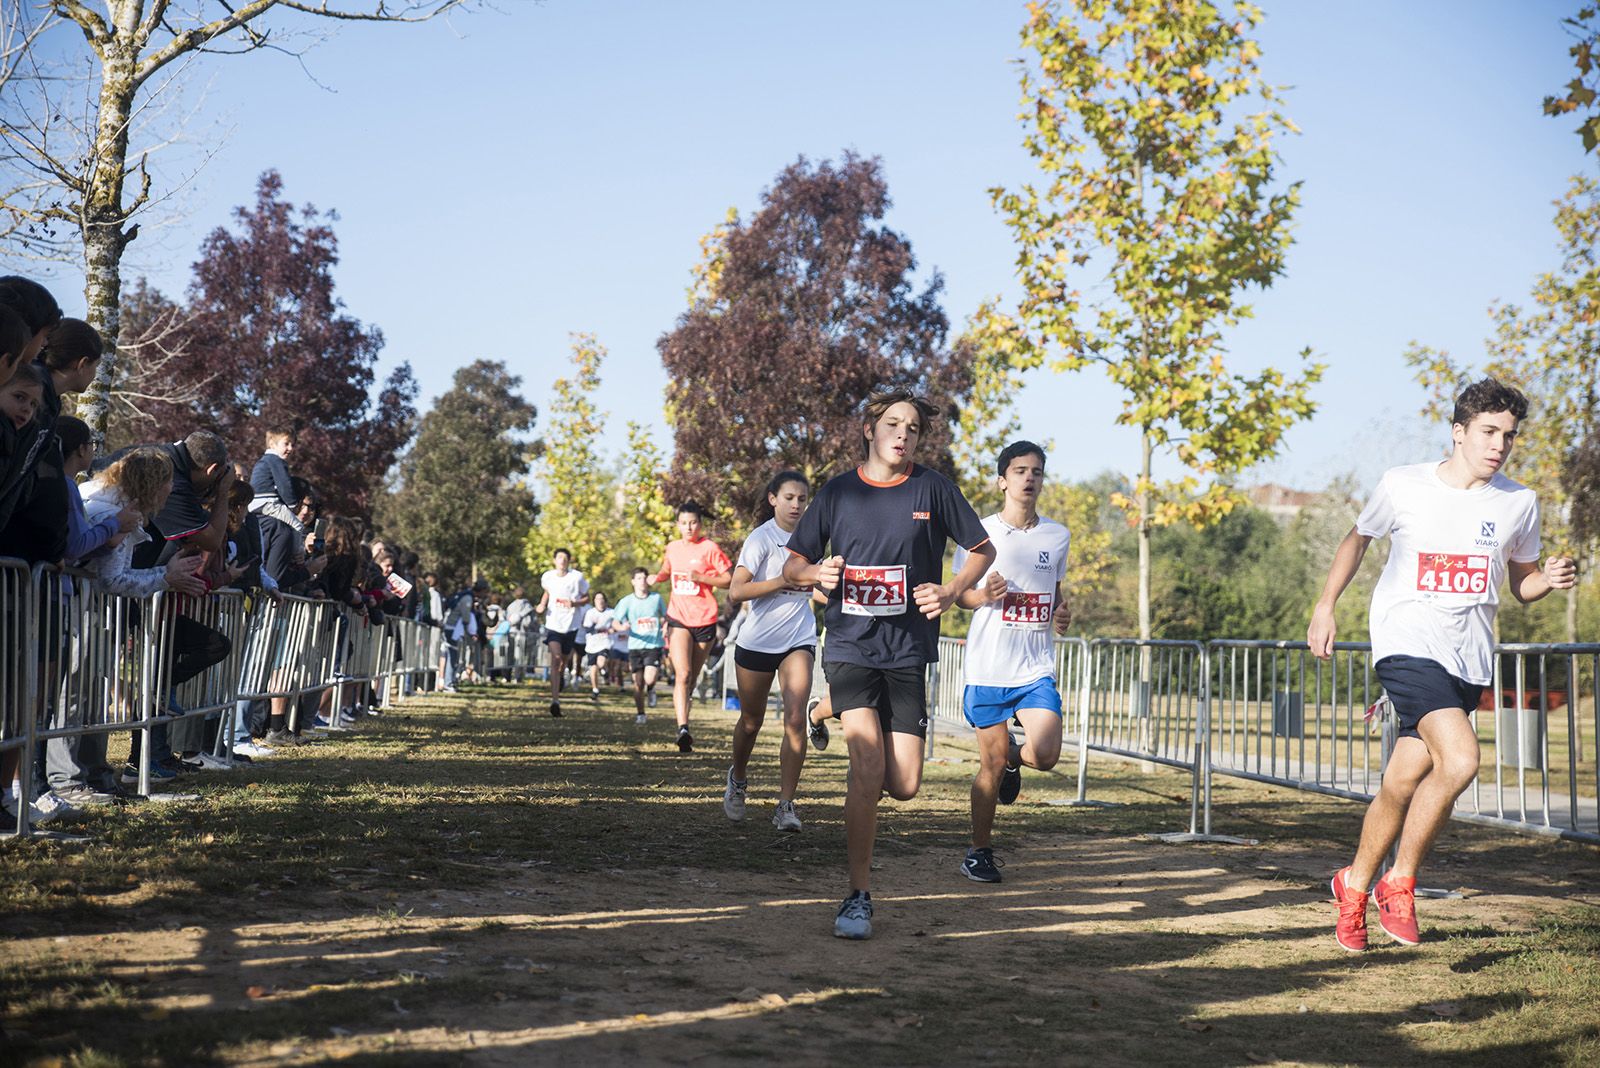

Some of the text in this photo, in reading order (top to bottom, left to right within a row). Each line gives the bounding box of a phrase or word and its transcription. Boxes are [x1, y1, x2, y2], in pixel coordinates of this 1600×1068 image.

[1420, 570, 1486, 592] 4106
[847, 584, 902, 604] 3721
[1005, 606, 1049, 622] 4118
